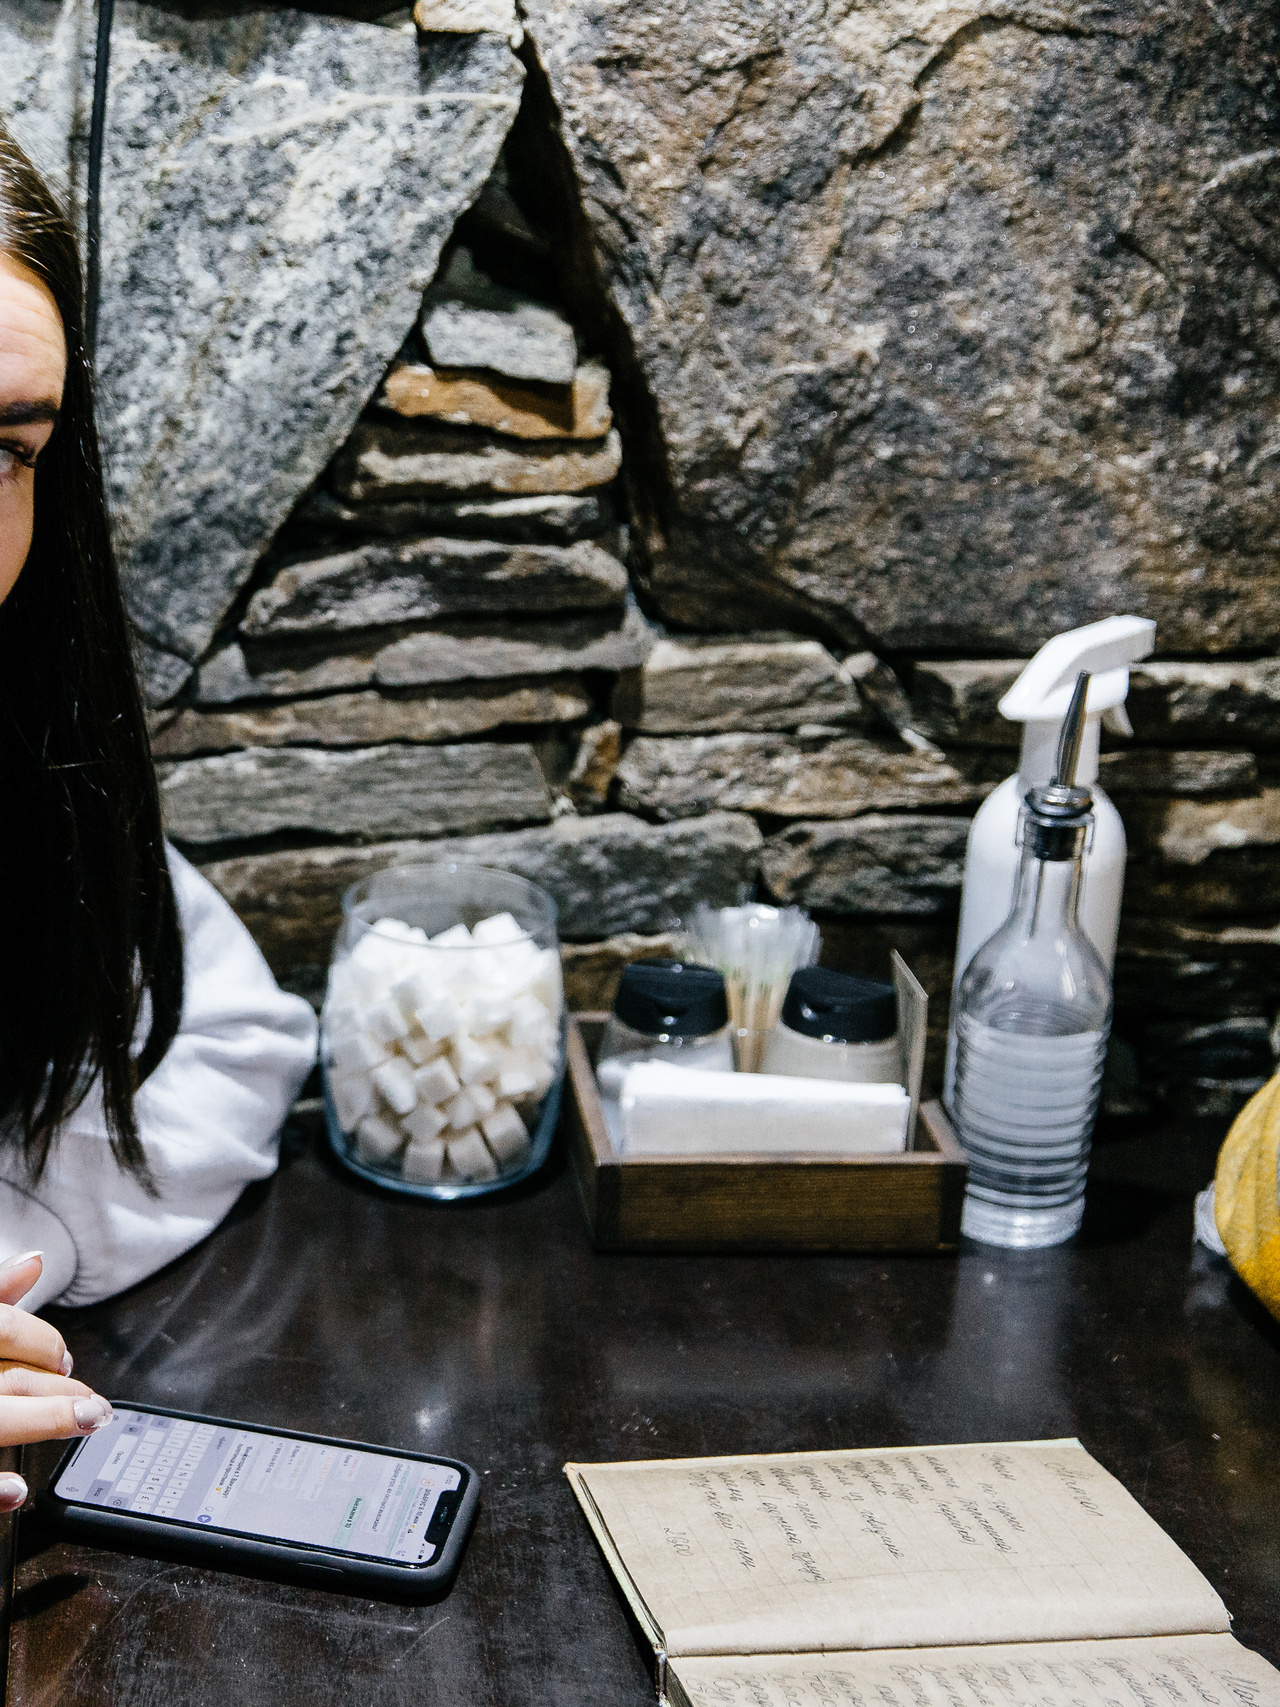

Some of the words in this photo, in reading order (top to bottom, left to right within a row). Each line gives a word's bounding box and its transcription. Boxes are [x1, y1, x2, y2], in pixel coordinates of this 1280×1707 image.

[1043, 1461, 1104, 1517] Мангал
[349, 1497, 362, 1519] Выезжаем
[662, 1526, 694, 1556] 2600
